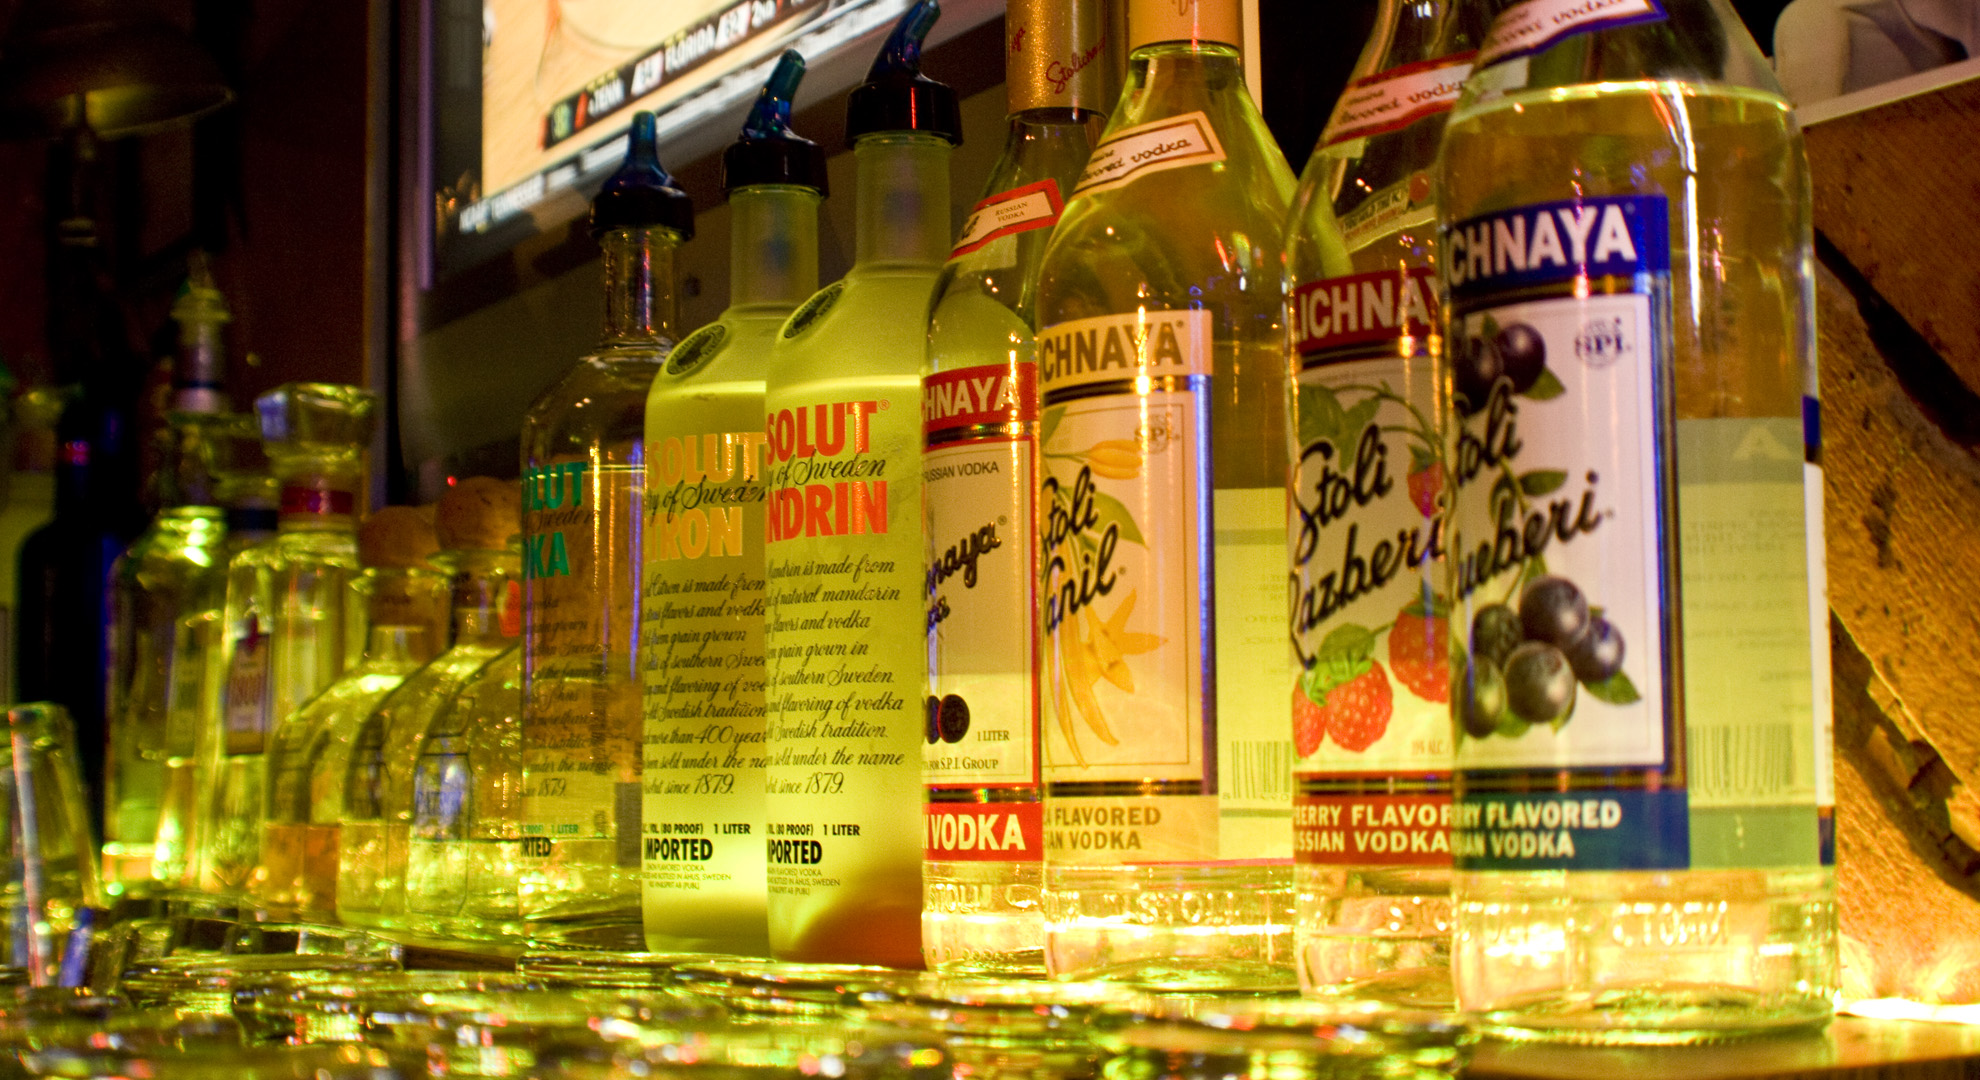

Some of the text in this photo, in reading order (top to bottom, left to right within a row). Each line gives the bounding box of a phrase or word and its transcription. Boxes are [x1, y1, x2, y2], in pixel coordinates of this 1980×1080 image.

[664, 25, 717, 74] FLORIDA
[1130, 138, 1193, 163] vodka
[994, 201, 1029, 217] RUSSIAN
[996, 211, 1026, 222] VODKA
[1449, 203, 1638, 288] CHNAYA
[1042, 321, 1184, 383] CHNAYA
[767, 401, 878, 467] SOLUT
[648, 432, 768, 491] SOLUT
[957, 461, 1000, 477] VODKA
[776, 453, 797, 501] of
[792, 448, 887, 486] Sweden
[662, 479, 685, 525] of
[680, 473, 767, 510] Sweden
[802, 561, 815, 576] is
[815, 554, 854, 575] made
[852, 553, 896, 583] from
[681, 579, 694, 594] is
[693, 573, 731, 594] made
[730, 572, 766, 600] from
[779, 583, 824, 606] natural
[821, 582, 901, 602] mandarin
[695, 599, 727, 618] and
[726, 598, 766, 617] vodka
[800, 610, 829, 631] and
[827, 609, 872, 630] vodka
[667, 629, 701, 658] grain
[697, 629, 747, 659] grown
[775, 643, 803, 670] grain
[802, 642, 848, 668] grown
[850, 641, 869, 656] in
[670, 653, 724, 669] southern
[779, 667, 826, 686] southern
[826, 662, 895, 687] Sweden.
[667, 675, 722, 703] flavoring
[722, 674, 745, 701] of
[656, 700, 704, 722] Swedish
[780, 692, 834, 722] flavoring
[835, 690, 857, 721] of
[854, 691, 905, 711] vodka
[669, 727, 695, 744] than
[694, 723, 734, 745] 400
[774, 718, 818, 742] Swedish
[820, 718, 889, 738] tradition.
[977, 730, 1010, 742] 1 LITER
[682, 751, 718, 769] under
[722, 750, 746, 769] the
[792, 746, 827, 766] under
[831, 745, 855, 765] the
[857, 752, 905, 766] name
[962, 756, 1000, 770] GROUP
[663, 780, 691, 795] since
[693, 773, 735, 795] 1879.
[778, 778, 802, 795] since
[804, 771, 845, 795] 1879.
[1055, 806, 1162, 827] FLAVORED
[1485, 799, 1623, 829] FLAVORED
[557, 824, 579, 834] LITER
[673, 823, 704, 835] PROOF)
[713, 823, 719, 835] 1
[722, 823, 752, 835] LITER
[823, 824, 828, 836] 1
[831, 824, 861, 836] LITER
[930, 813, 1027, 851] VODKA
[1069, 830, 1142, 850] VODKA
[1353, 830, 1450, 853] VODKA
[1489, 829, 1576, 859] VODKA
[701, 873, 732, 881] SWEDEN
[811, 878, 841, 887] SWEDEN
